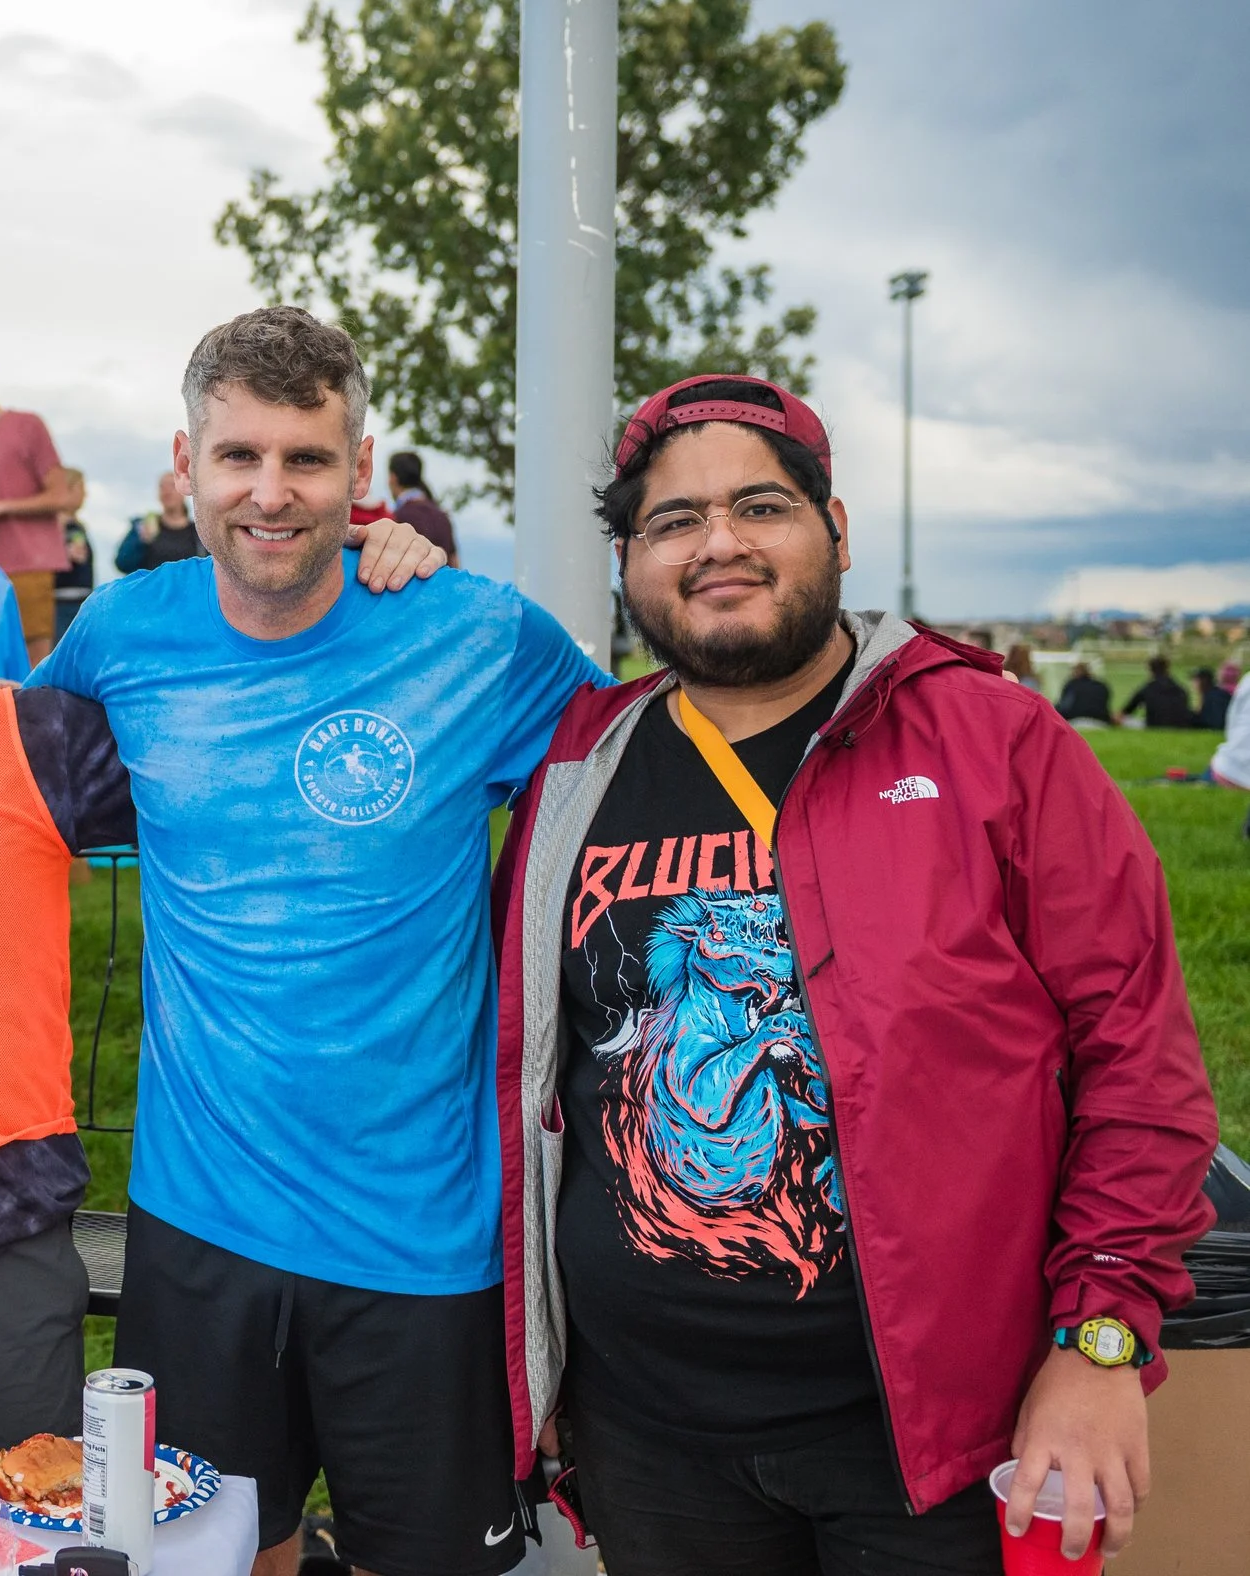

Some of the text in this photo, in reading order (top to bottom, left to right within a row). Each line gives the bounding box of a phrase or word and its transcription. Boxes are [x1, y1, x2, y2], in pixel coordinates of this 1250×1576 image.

[309, 717, 404, 755] BARE BONES
[894, 776, 917, 789] THE
[303, 774, 404, 817] SOCCER COLLECTIVE
[878, 783, 918, 800] NORTH
[891, 791, 920, 805] FACE
